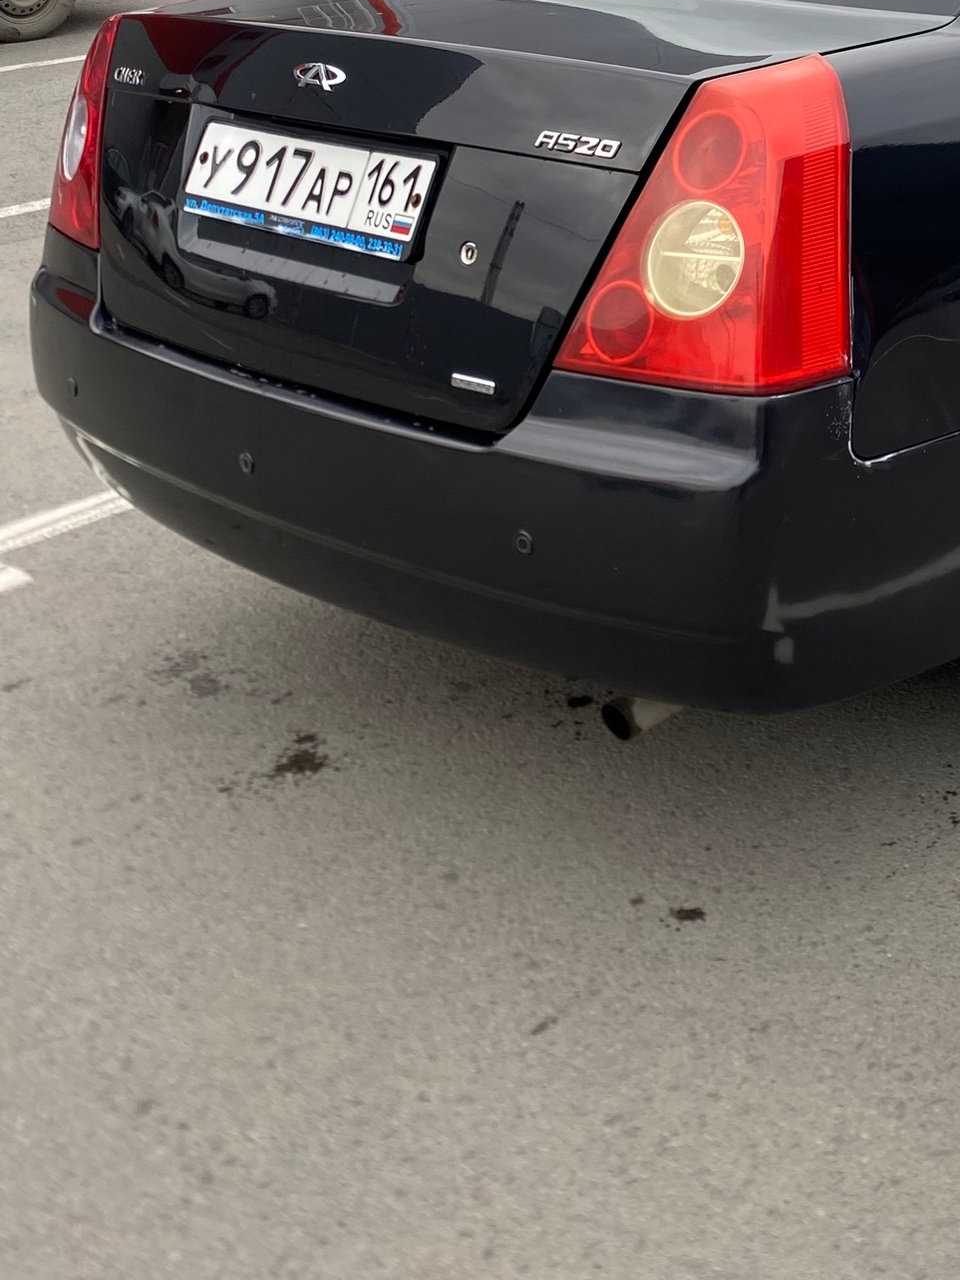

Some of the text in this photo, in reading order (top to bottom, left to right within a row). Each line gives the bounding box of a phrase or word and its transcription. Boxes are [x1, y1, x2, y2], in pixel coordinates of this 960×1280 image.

[114, 66, 146, 86] CHERY
[534, 130, 622, 158] A520
[203, 139, 422, 216] У917АР 161
[364, 209, 392, 230] RUS
